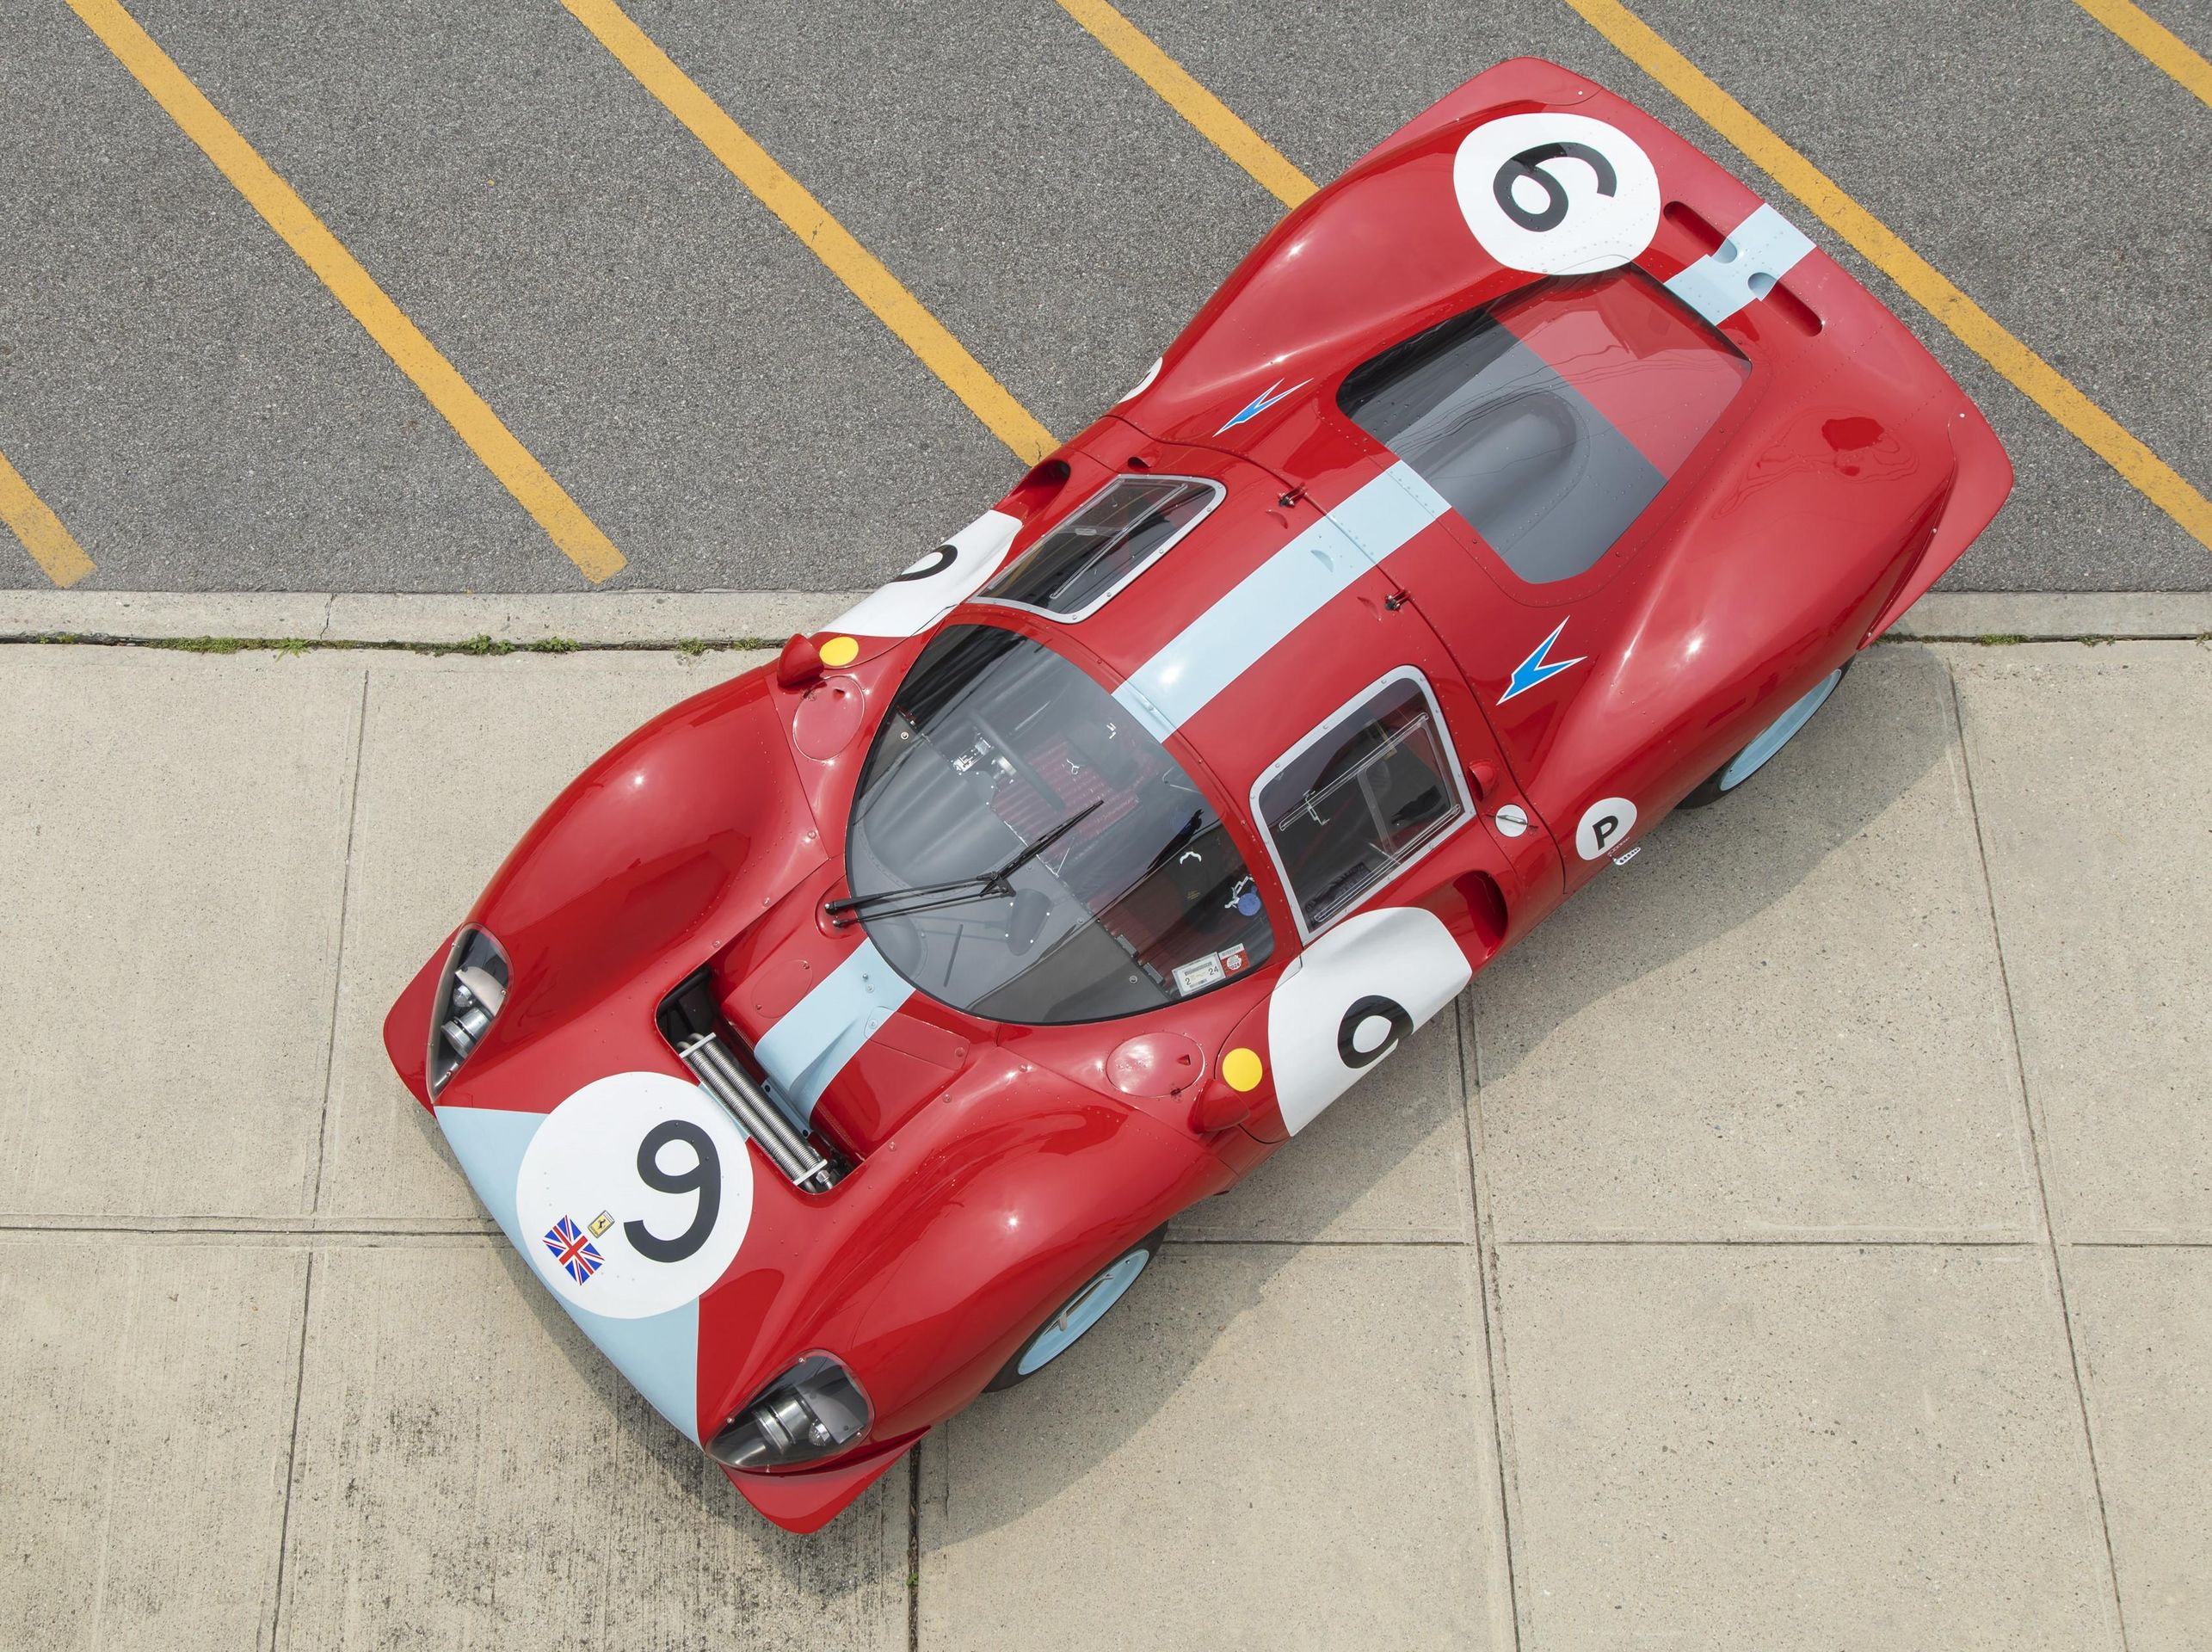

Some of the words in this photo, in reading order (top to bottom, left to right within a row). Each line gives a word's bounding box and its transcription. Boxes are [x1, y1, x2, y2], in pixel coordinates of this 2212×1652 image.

[1592, 815, 1619, 851] P
[1208, 965, 1219, 976] 24
[623, 1119, 722, 1263] 9
